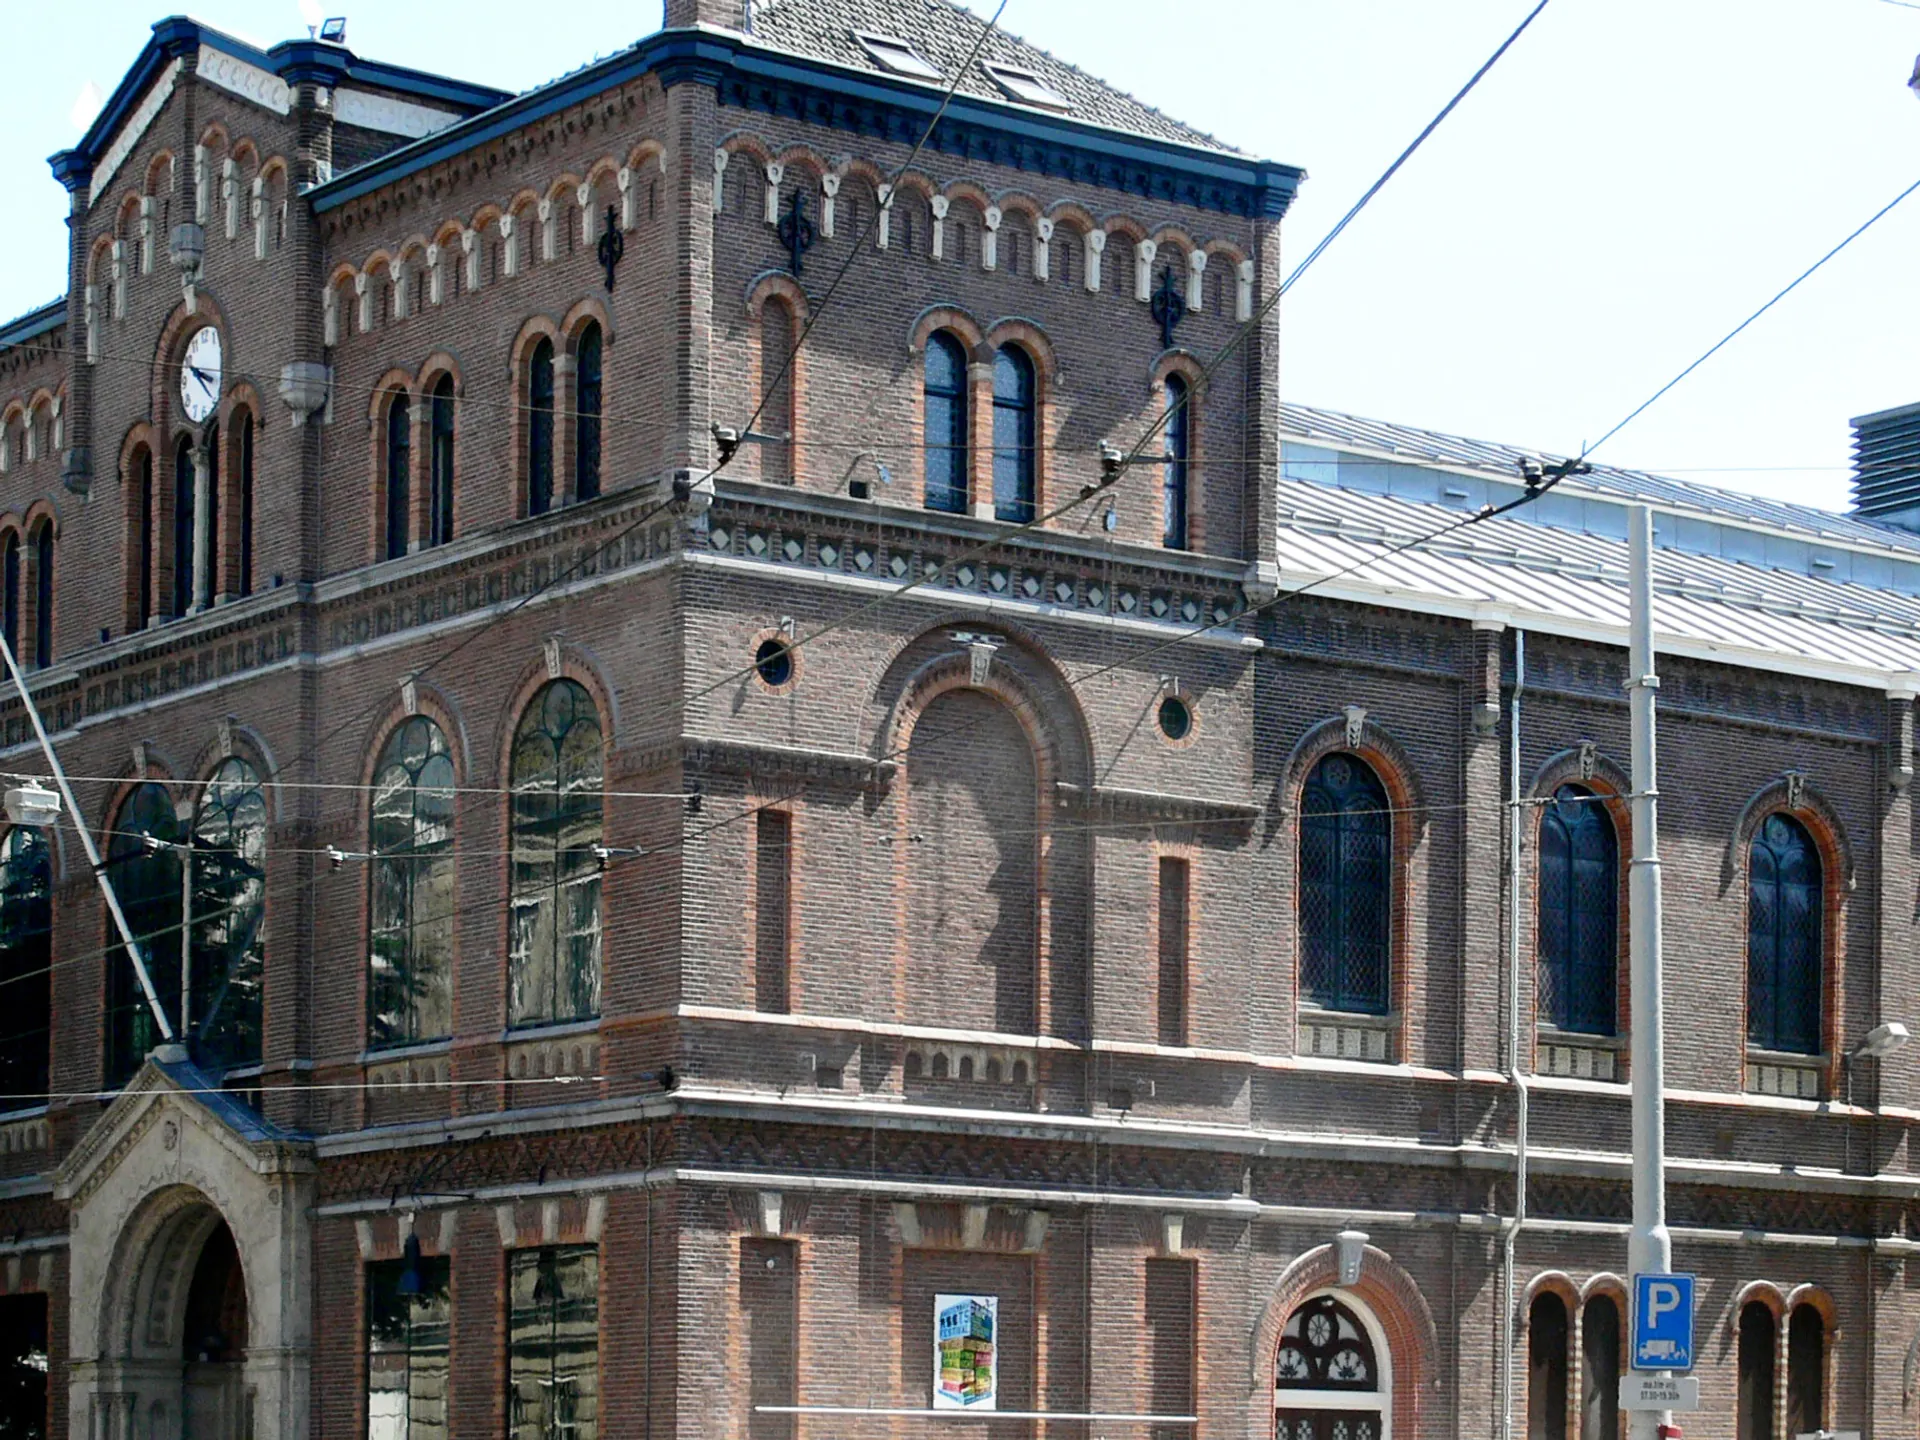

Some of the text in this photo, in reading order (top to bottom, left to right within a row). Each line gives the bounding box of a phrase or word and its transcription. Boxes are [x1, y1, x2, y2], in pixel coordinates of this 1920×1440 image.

[200, 328, 209, 344] 12
[191, 338, 199, 353] 11
[182, 375, 187, 390] 9
[185, 392, 191, 408] 8
[192, 404, 198, 419] 7
[1648, 1283, 1680, 1329] P
